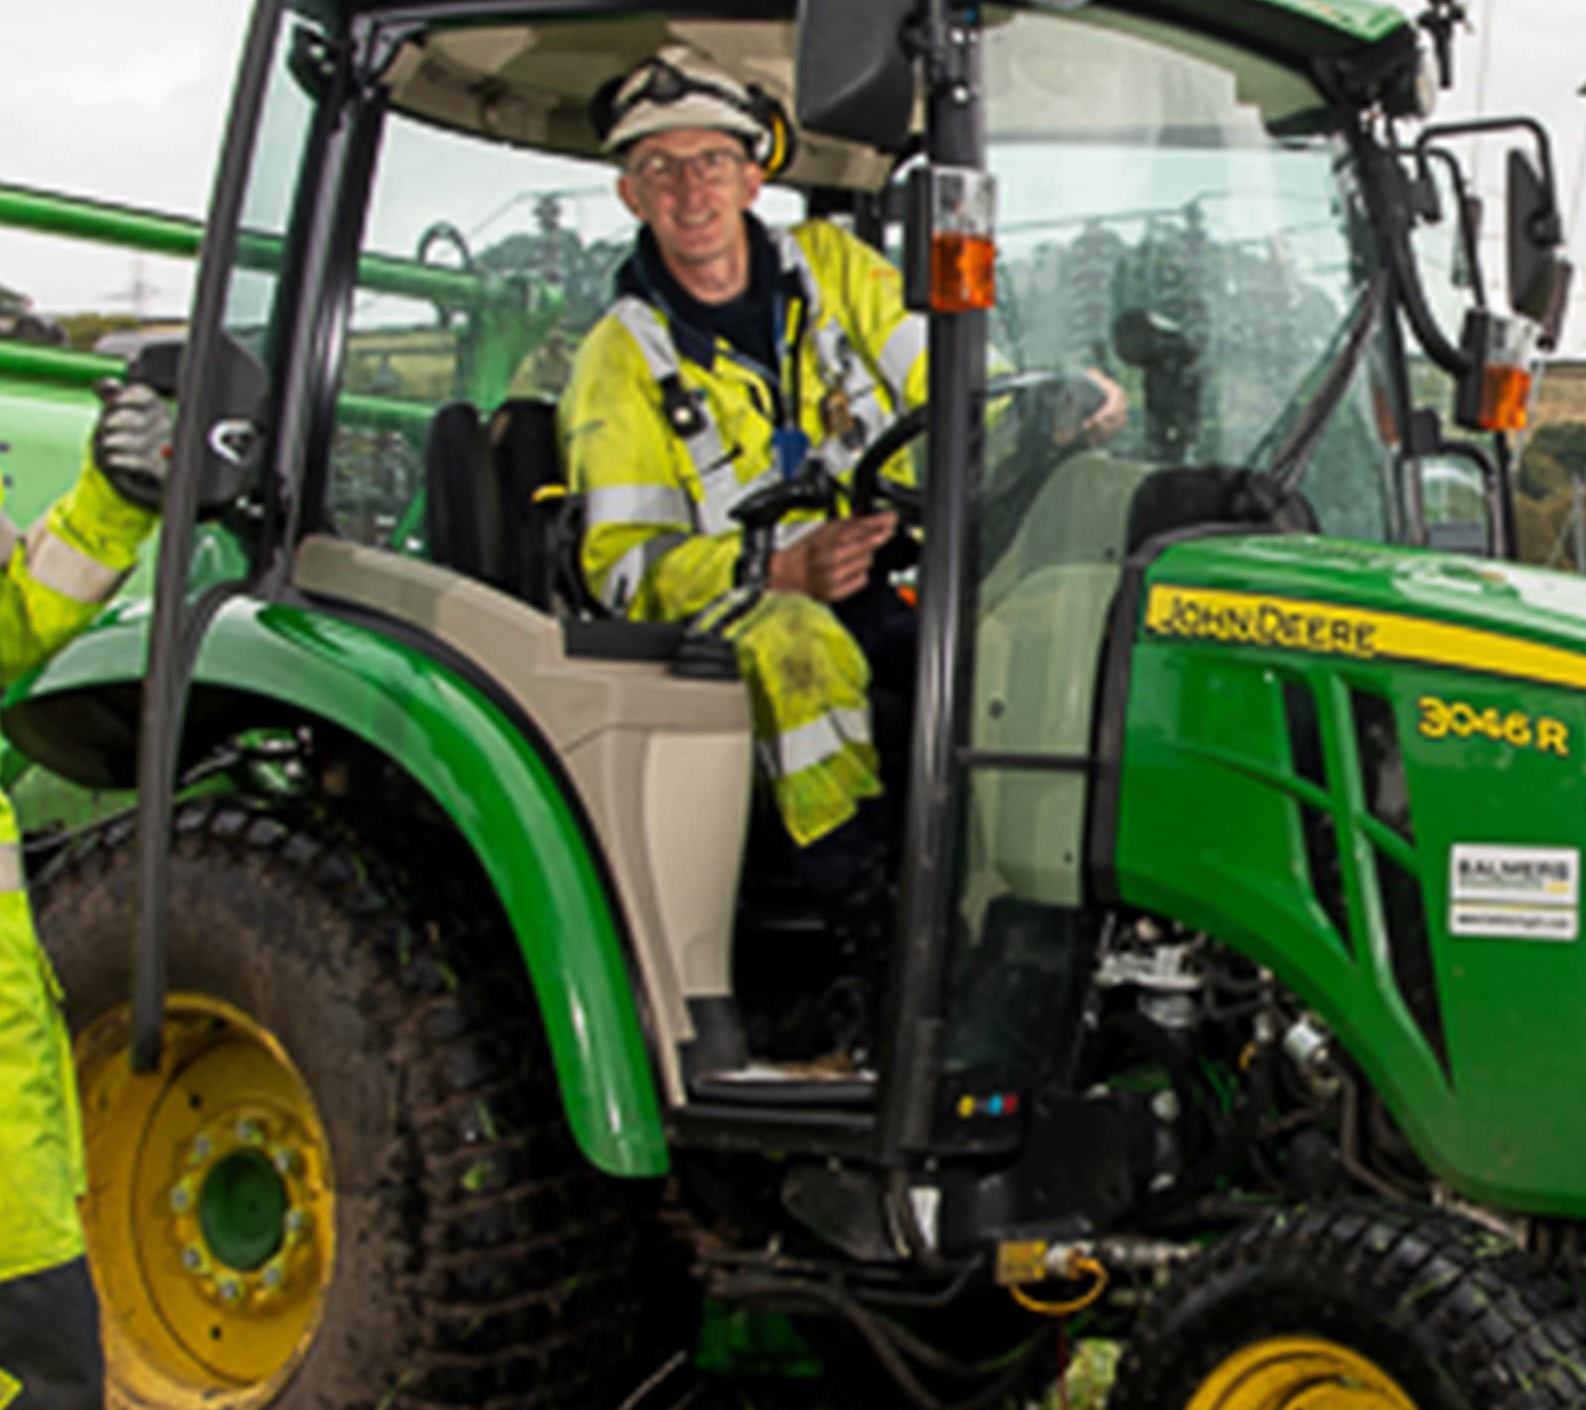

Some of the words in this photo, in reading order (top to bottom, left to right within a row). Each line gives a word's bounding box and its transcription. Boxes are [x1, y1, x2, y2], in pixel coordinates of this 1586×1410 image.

[1161, 596, 1254, 640] JOHN
[1257, 604, 1377, 655] DEERE
[1418, 695, 1570, 758] 3046R
